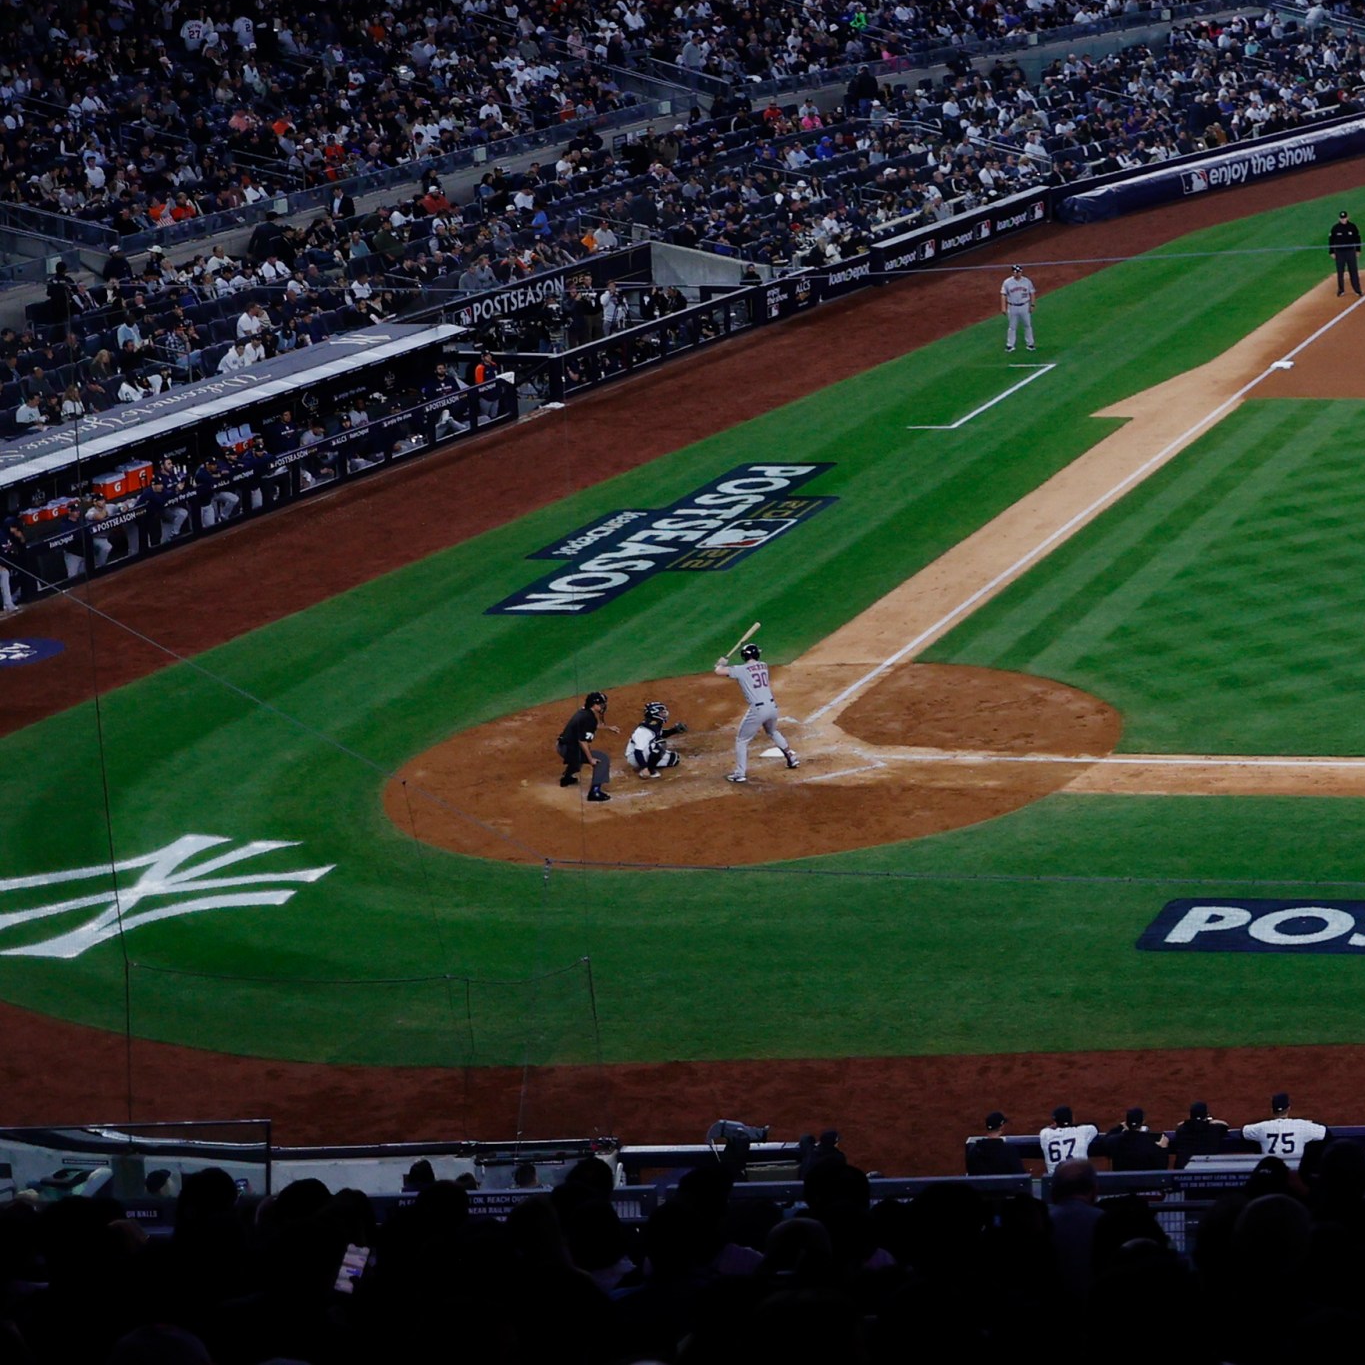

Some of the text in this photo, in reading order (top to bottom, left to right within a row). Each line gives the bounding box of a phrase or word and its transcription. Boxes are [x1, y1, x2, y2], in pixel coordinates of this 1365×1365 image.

[1208, 145, 1317, 186] enjoy the show.
[473, 275, 565, 323] POSTSEASON
[503, 465, 817, 611] POSTSEASON
[751, 672, 769, 688] 30
[1046, 1137, 1077, 1164] 67
[1267, 1133, 1296, 1154] 75
